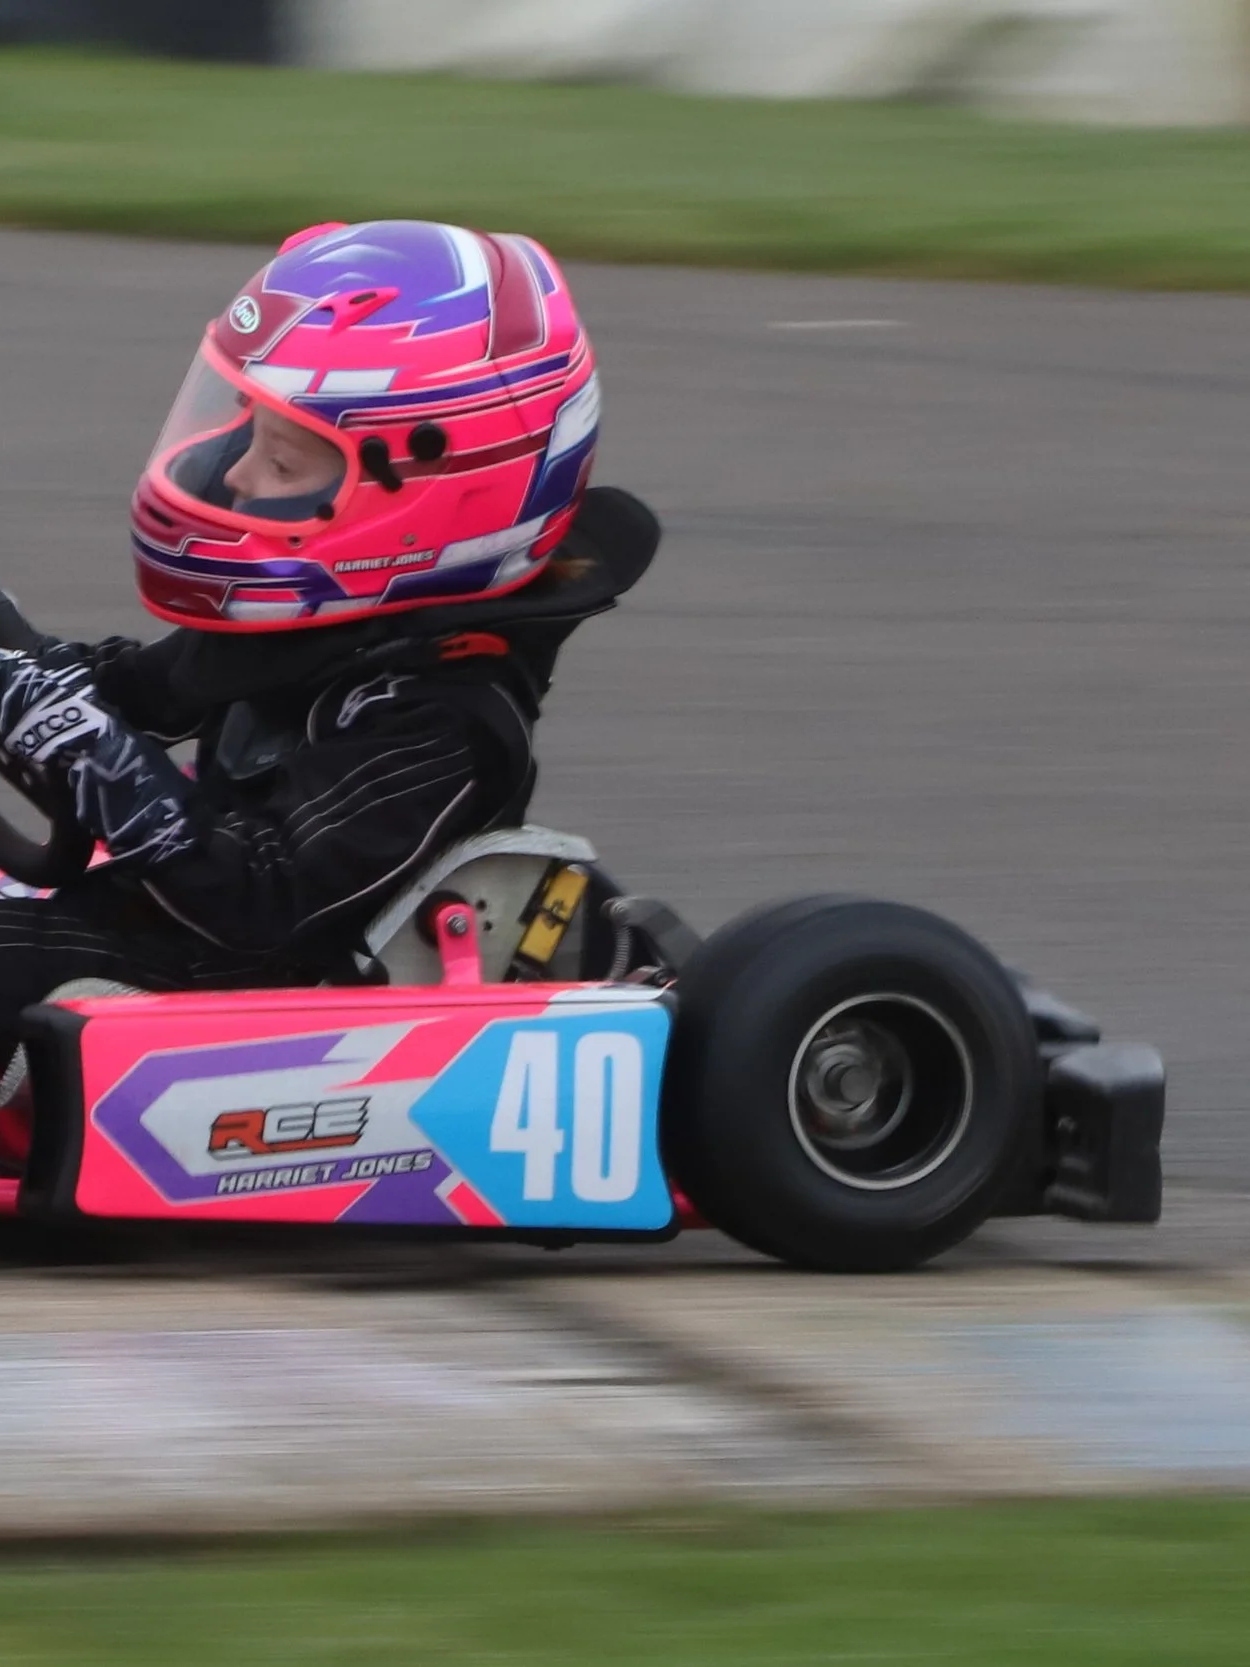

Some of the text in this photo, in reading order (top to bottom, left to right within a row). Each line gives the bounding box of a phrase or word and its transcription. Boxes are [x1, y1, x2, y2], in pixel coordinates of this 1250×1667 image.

[15, 705, 83, 756] arco
[208, 1096, 372, 1156] RCE
[489, 1030, 643, 1202] 40
[216, 1151, 434, 1195] HARRIET JONES
